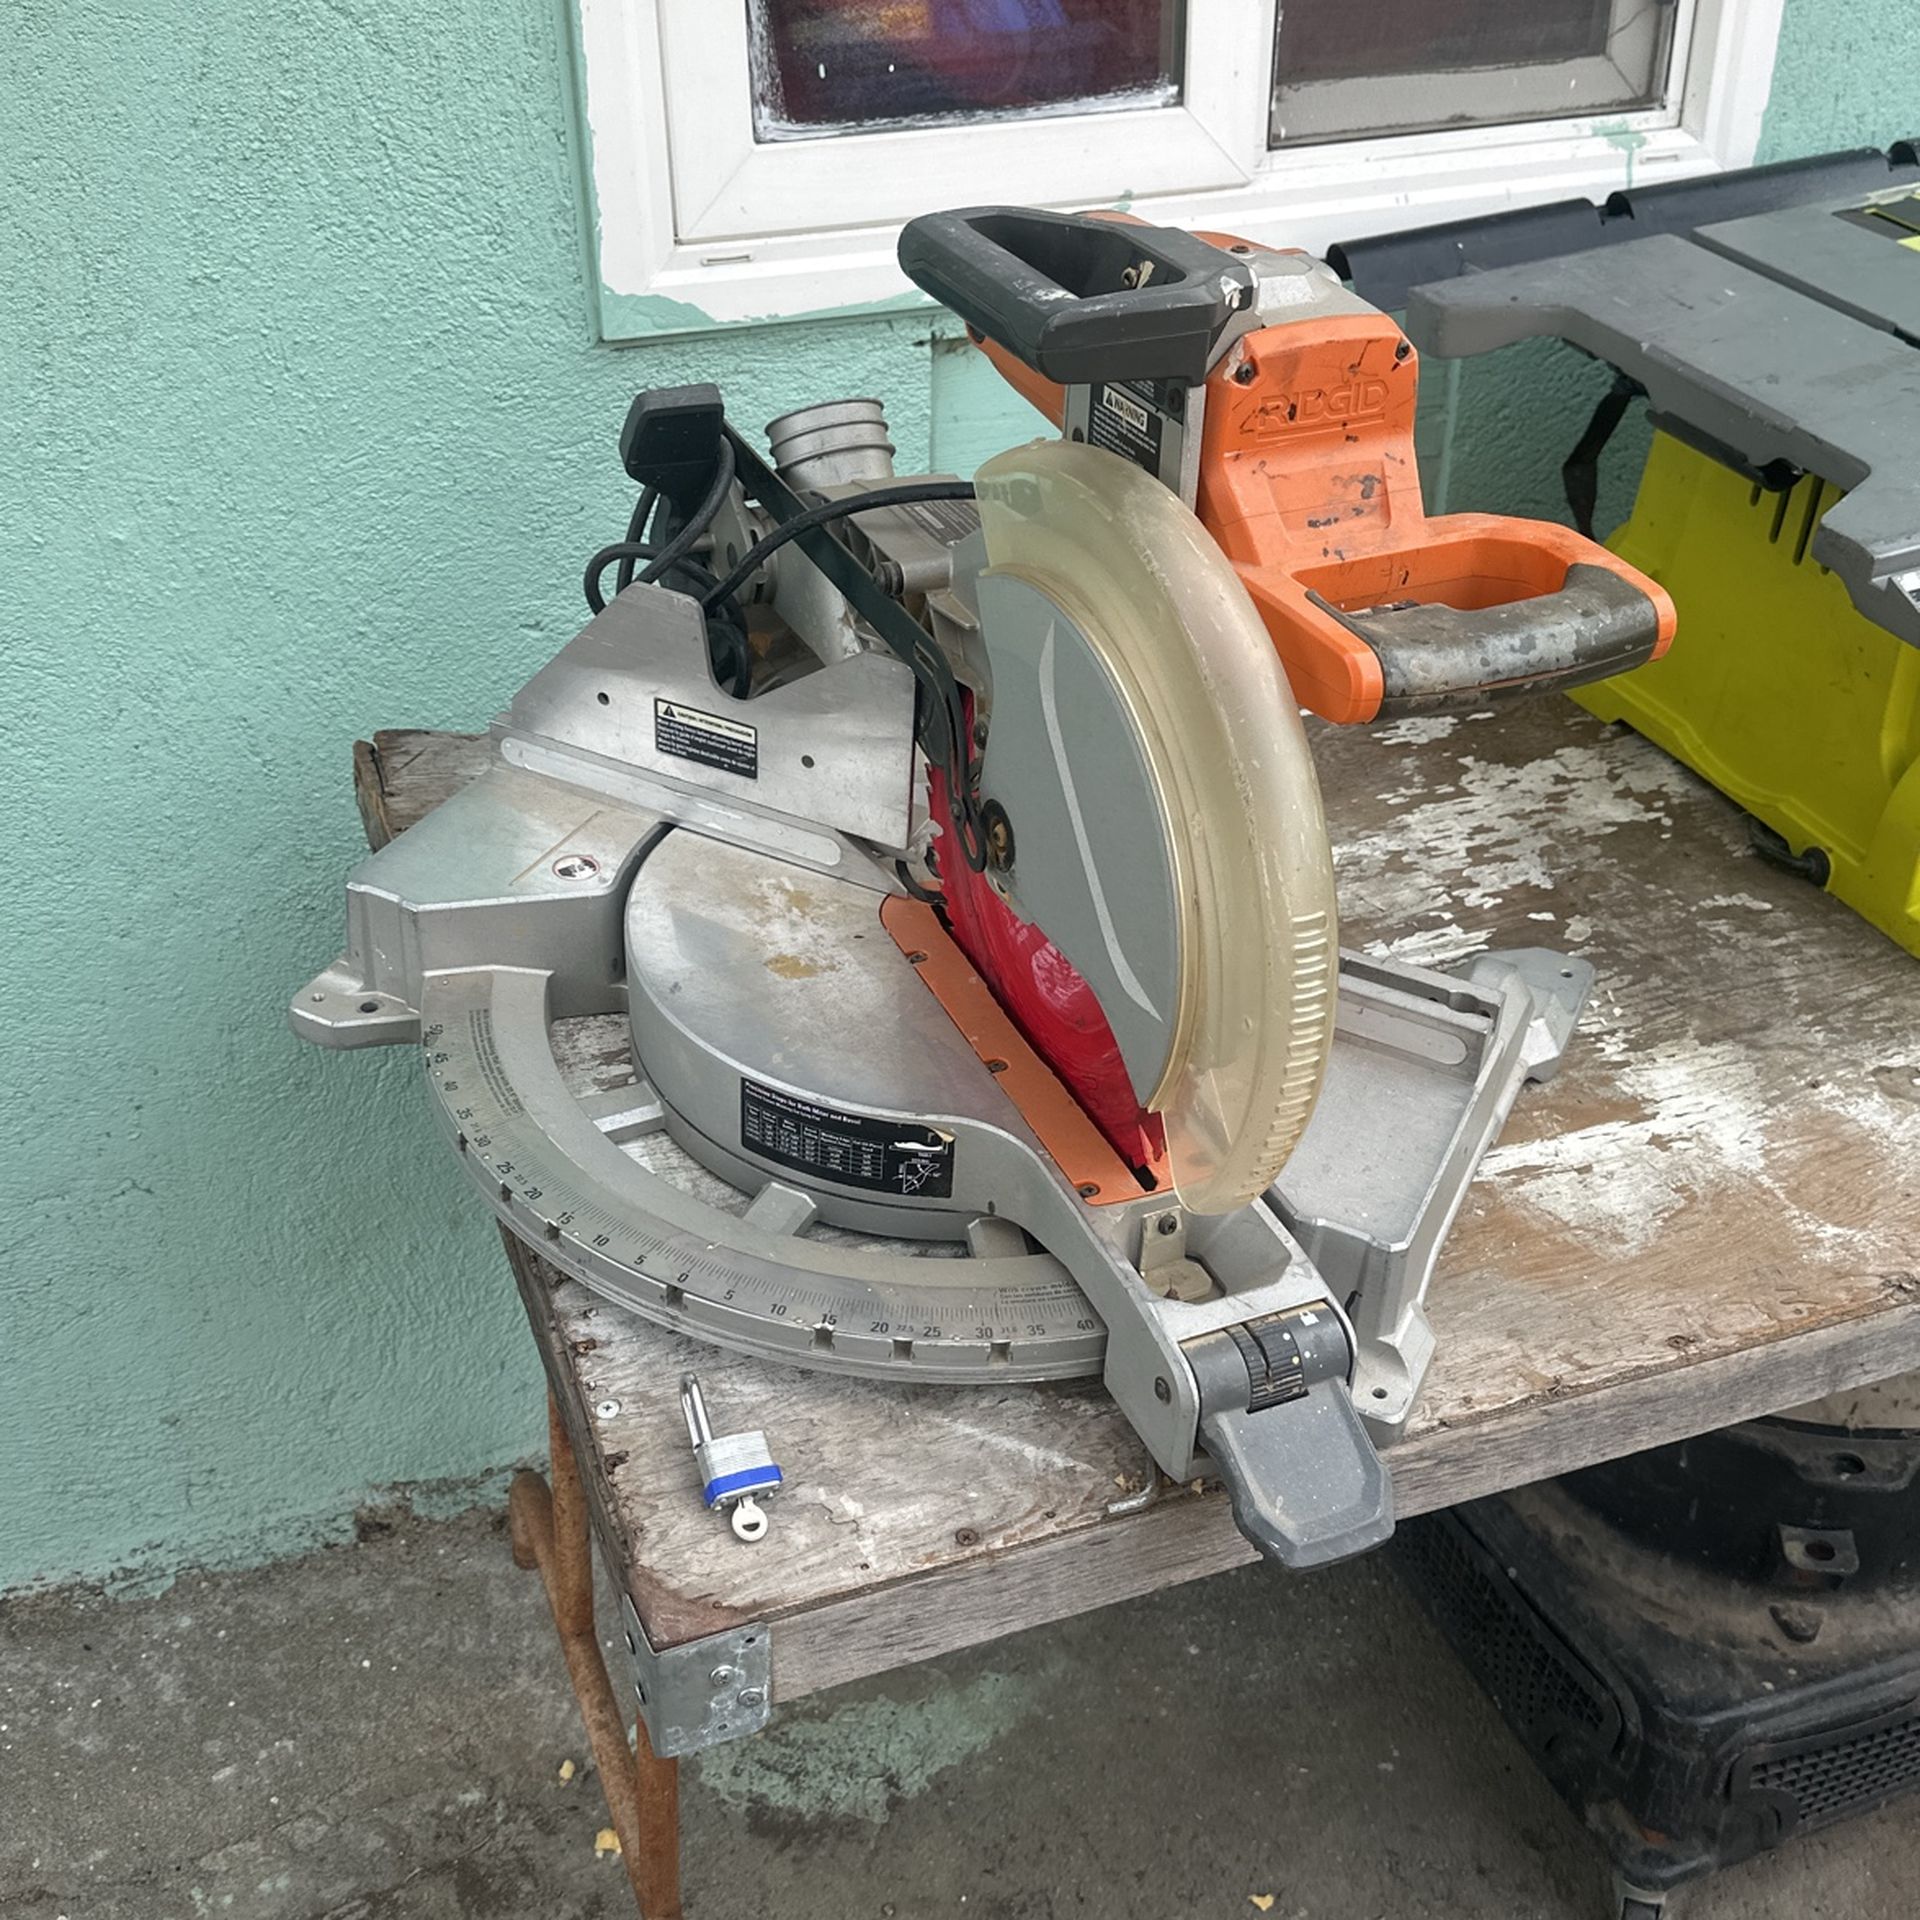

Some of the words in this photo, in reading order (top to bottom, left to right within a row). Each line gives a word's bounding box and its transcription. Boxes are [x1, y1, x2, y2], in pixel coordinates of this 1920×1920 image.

[1259, 379, 1389, 430] RIDGID
[429, 1024, 443, 1036] 50
[434, 1053, 448, 1064] 45
[444, 1081, 458, 1092] 40
[456, 1106, 473, 1121] 35
[830, 1113, 842, 1121] and
[474, 1135, 491, 1148] 30
[497, 1161, 515, 1174] 25
[524, 1187, 543, 1200] 20
[557, 1211, 574, 1225] 15
[593, 1235, 610, 1247] 10
[634, 1255, 647, 1265] 5
[678, 1273, 689, 1283] 0
[723, 1290, 736, 1301] 5
[769, 1303, 787, 1316] 10
[820, 1313, 837, 1326] 15
[1077, 1319, 1095, 1331] 40
[870, 1321, 889, 1334] 20
[923, 1326, 941, 1338] 25
[975, 1326, 993, 1339] 30
[1028, 1324, 1046, 1336] 35
